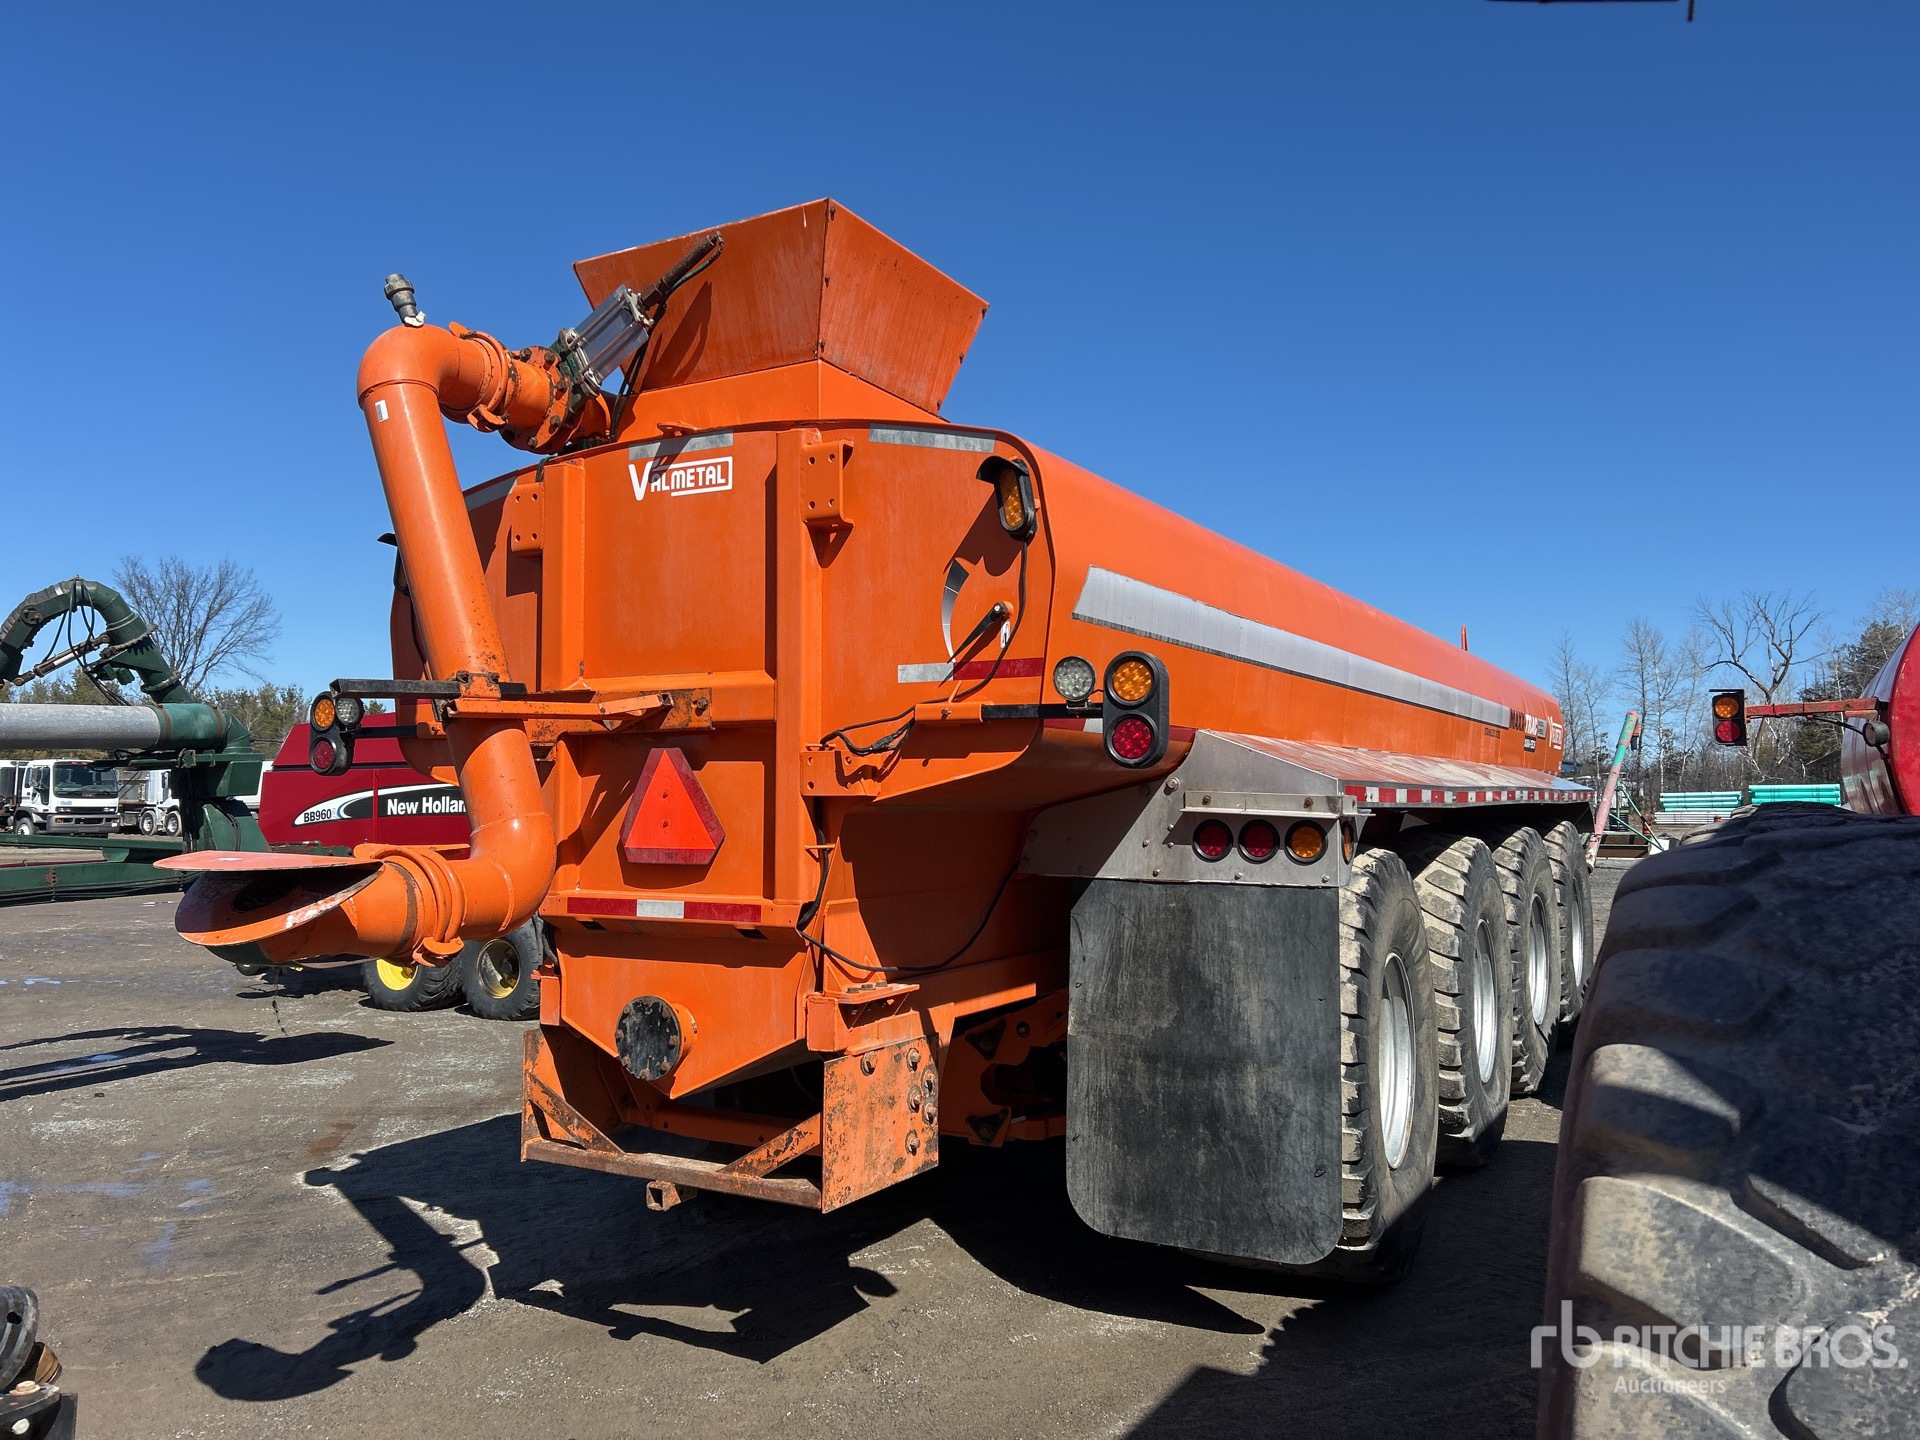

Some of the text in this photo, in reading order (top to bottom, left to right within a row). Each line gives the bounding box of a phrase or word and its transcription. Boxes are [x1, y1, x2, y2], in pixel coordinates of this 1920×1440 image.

[628, 457, 733, 501] VALMETAL
[303, 808, 332, 823] BB960
[387, 795, 467, 816] New Hollan
